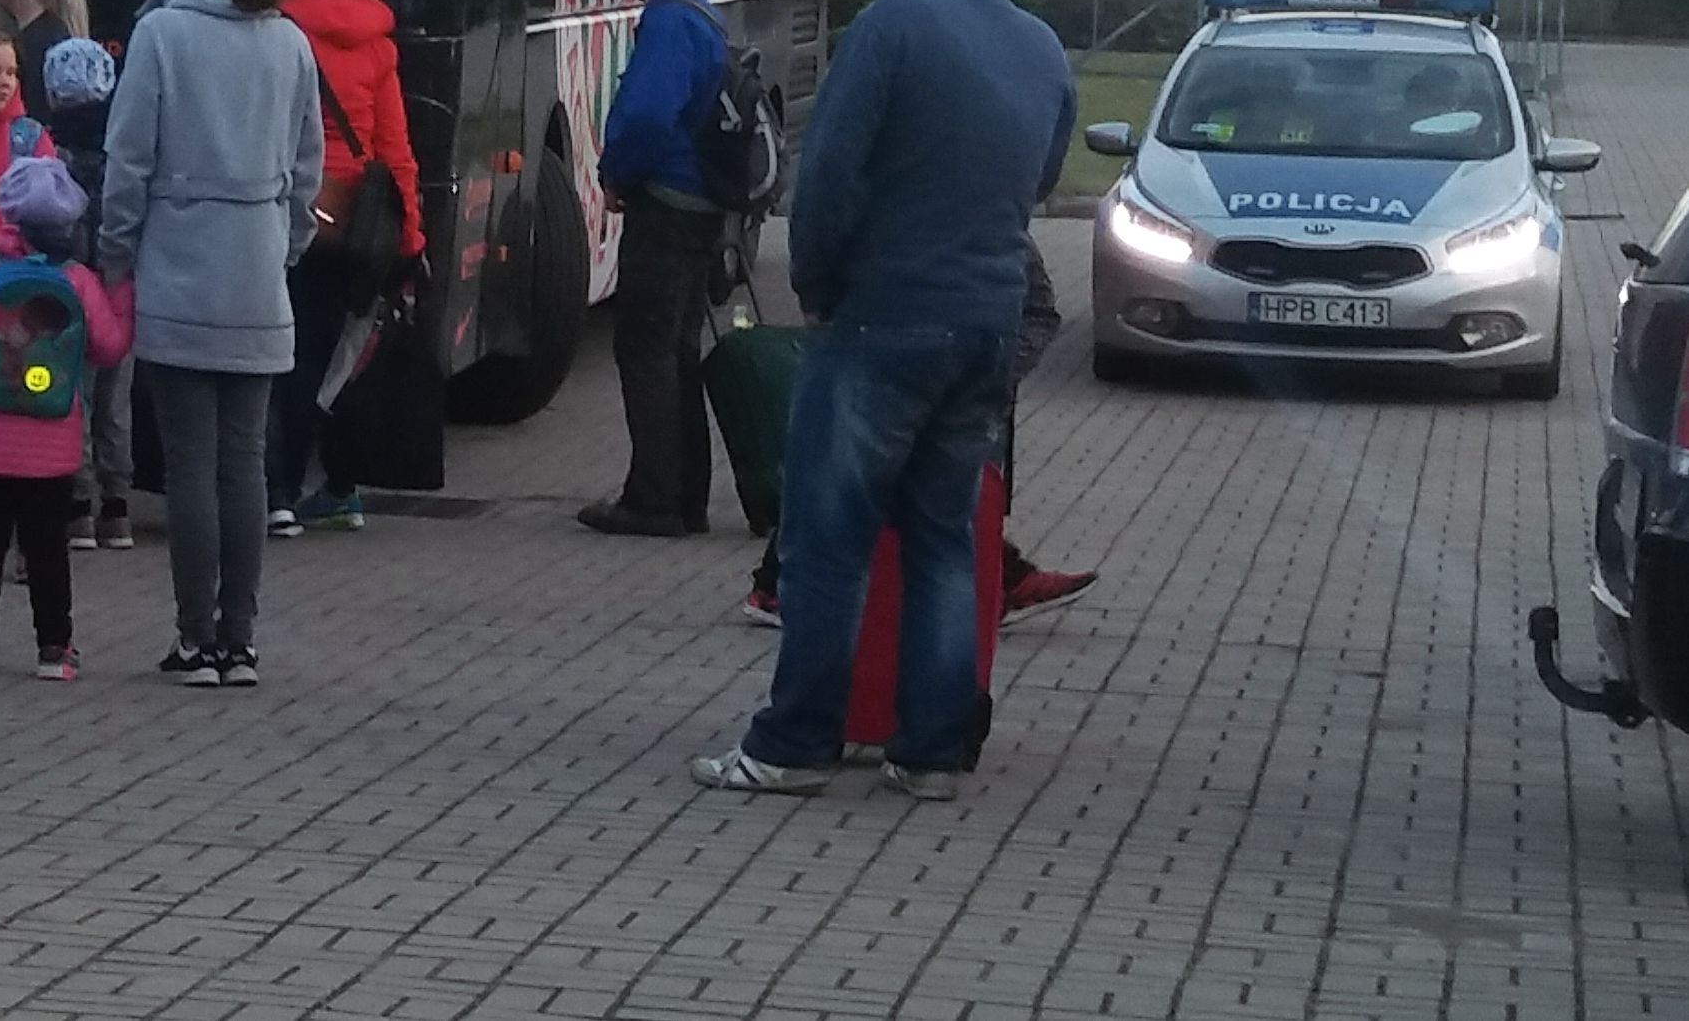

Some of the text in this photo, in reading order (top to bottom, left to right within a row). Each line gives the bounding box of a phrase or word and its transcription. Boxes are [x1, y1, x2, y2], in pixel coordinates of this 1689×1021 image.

[1228, 191, 1412, 218] POLICJA
[1264, 298, 1384, 325] HPB C413
